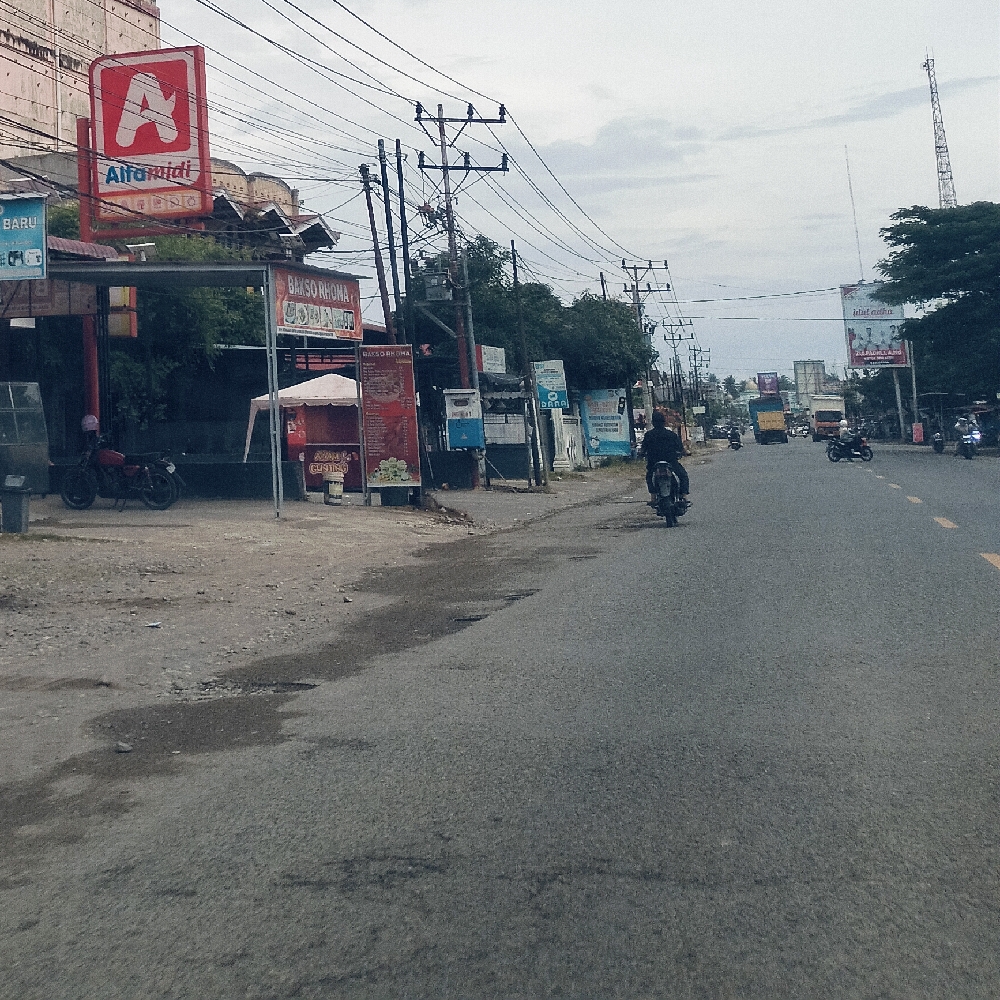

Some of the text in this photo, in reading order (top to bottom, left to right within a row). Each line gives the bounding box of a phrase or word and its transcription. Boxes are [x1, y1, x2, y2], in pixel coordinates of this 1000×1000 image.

[105, 159, 191, 184] Alfamidi
[2, 215, 38, 230] BARU
[287, 275, 350, 303] BAKSO RHOMA
[541, 400, 567, 408] DANA
